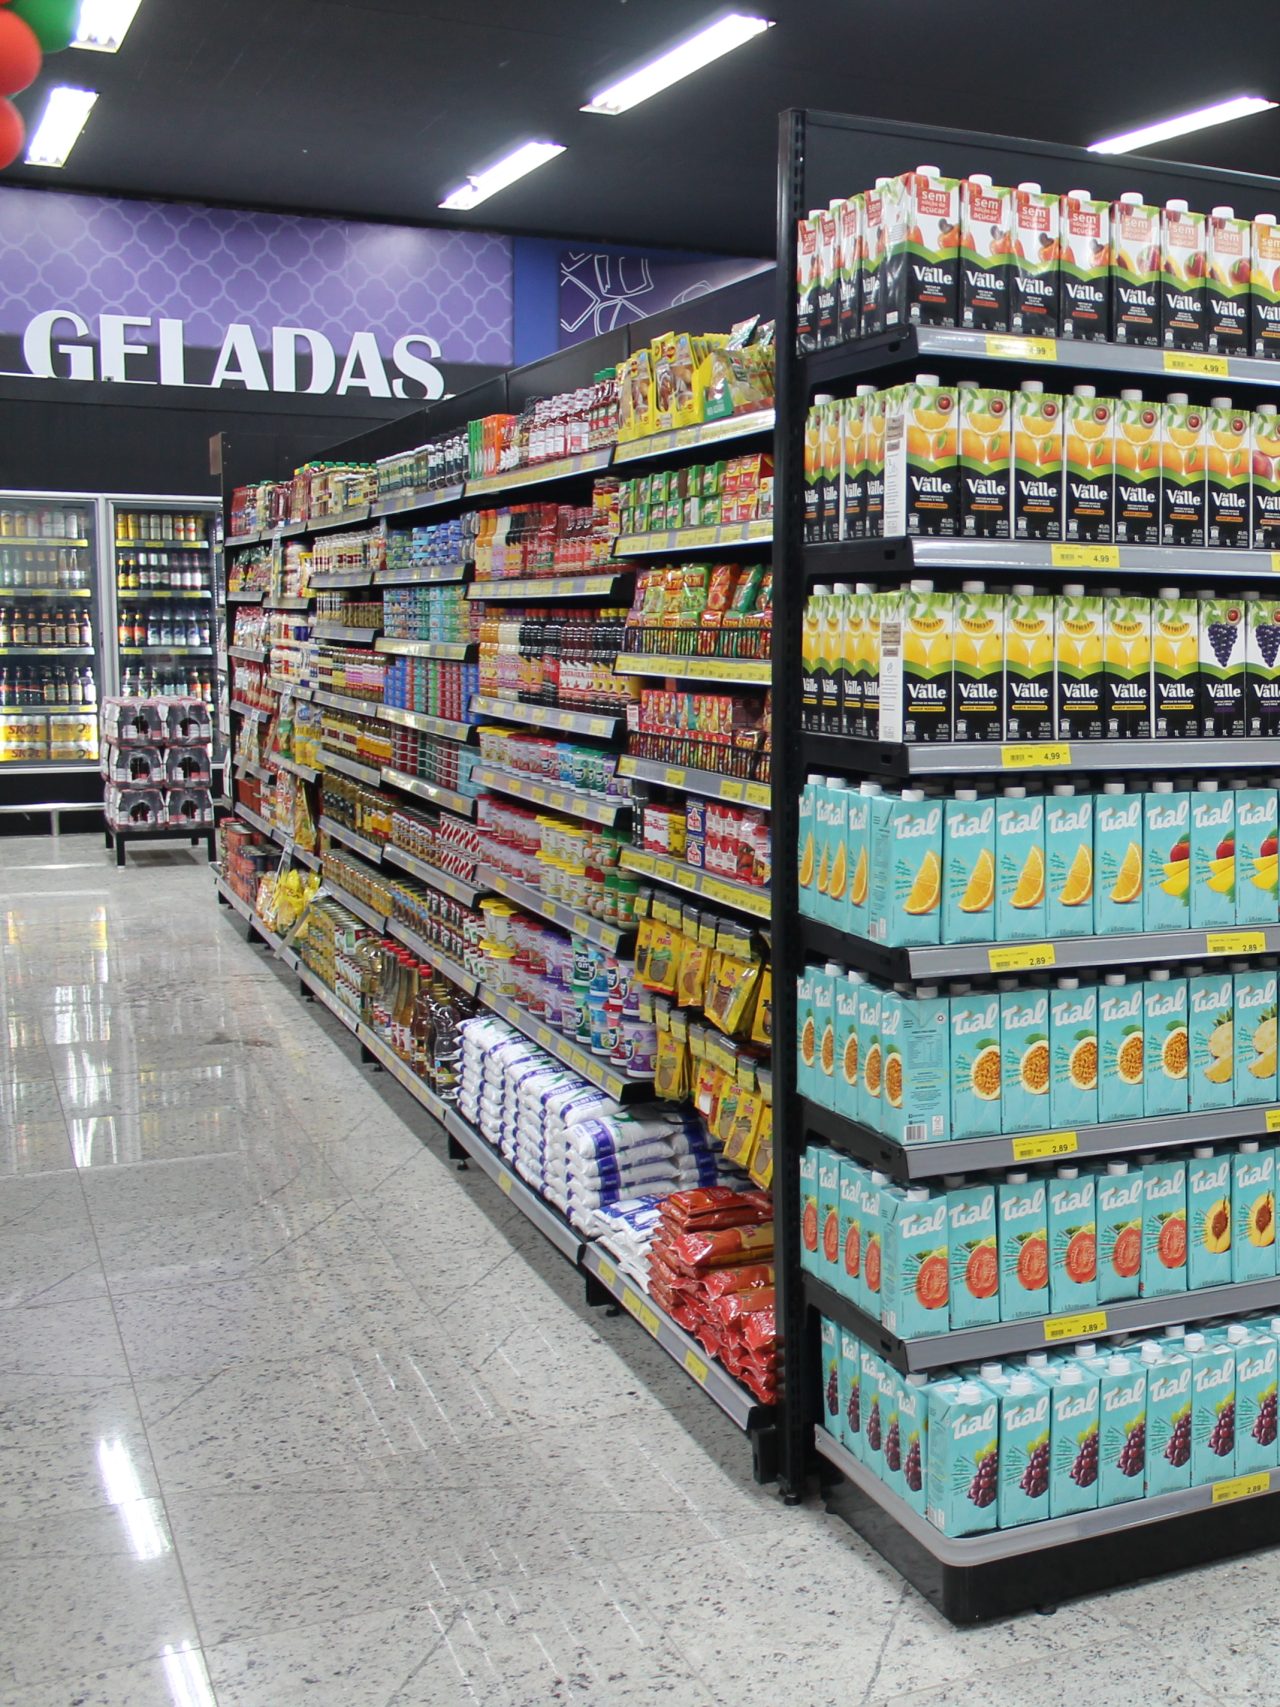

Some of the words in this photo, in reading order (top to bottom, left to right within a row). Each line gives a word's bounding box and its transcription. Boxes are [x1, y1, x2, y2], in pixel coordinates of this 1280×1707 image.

[921, 190, 947, 202] sem
[974, 197, 999, 210] sem
[1022, 205, 1046, 218] sem
[1072, 212, 1097, 224] sem
[23, 309, 446, 400] GELADAS
